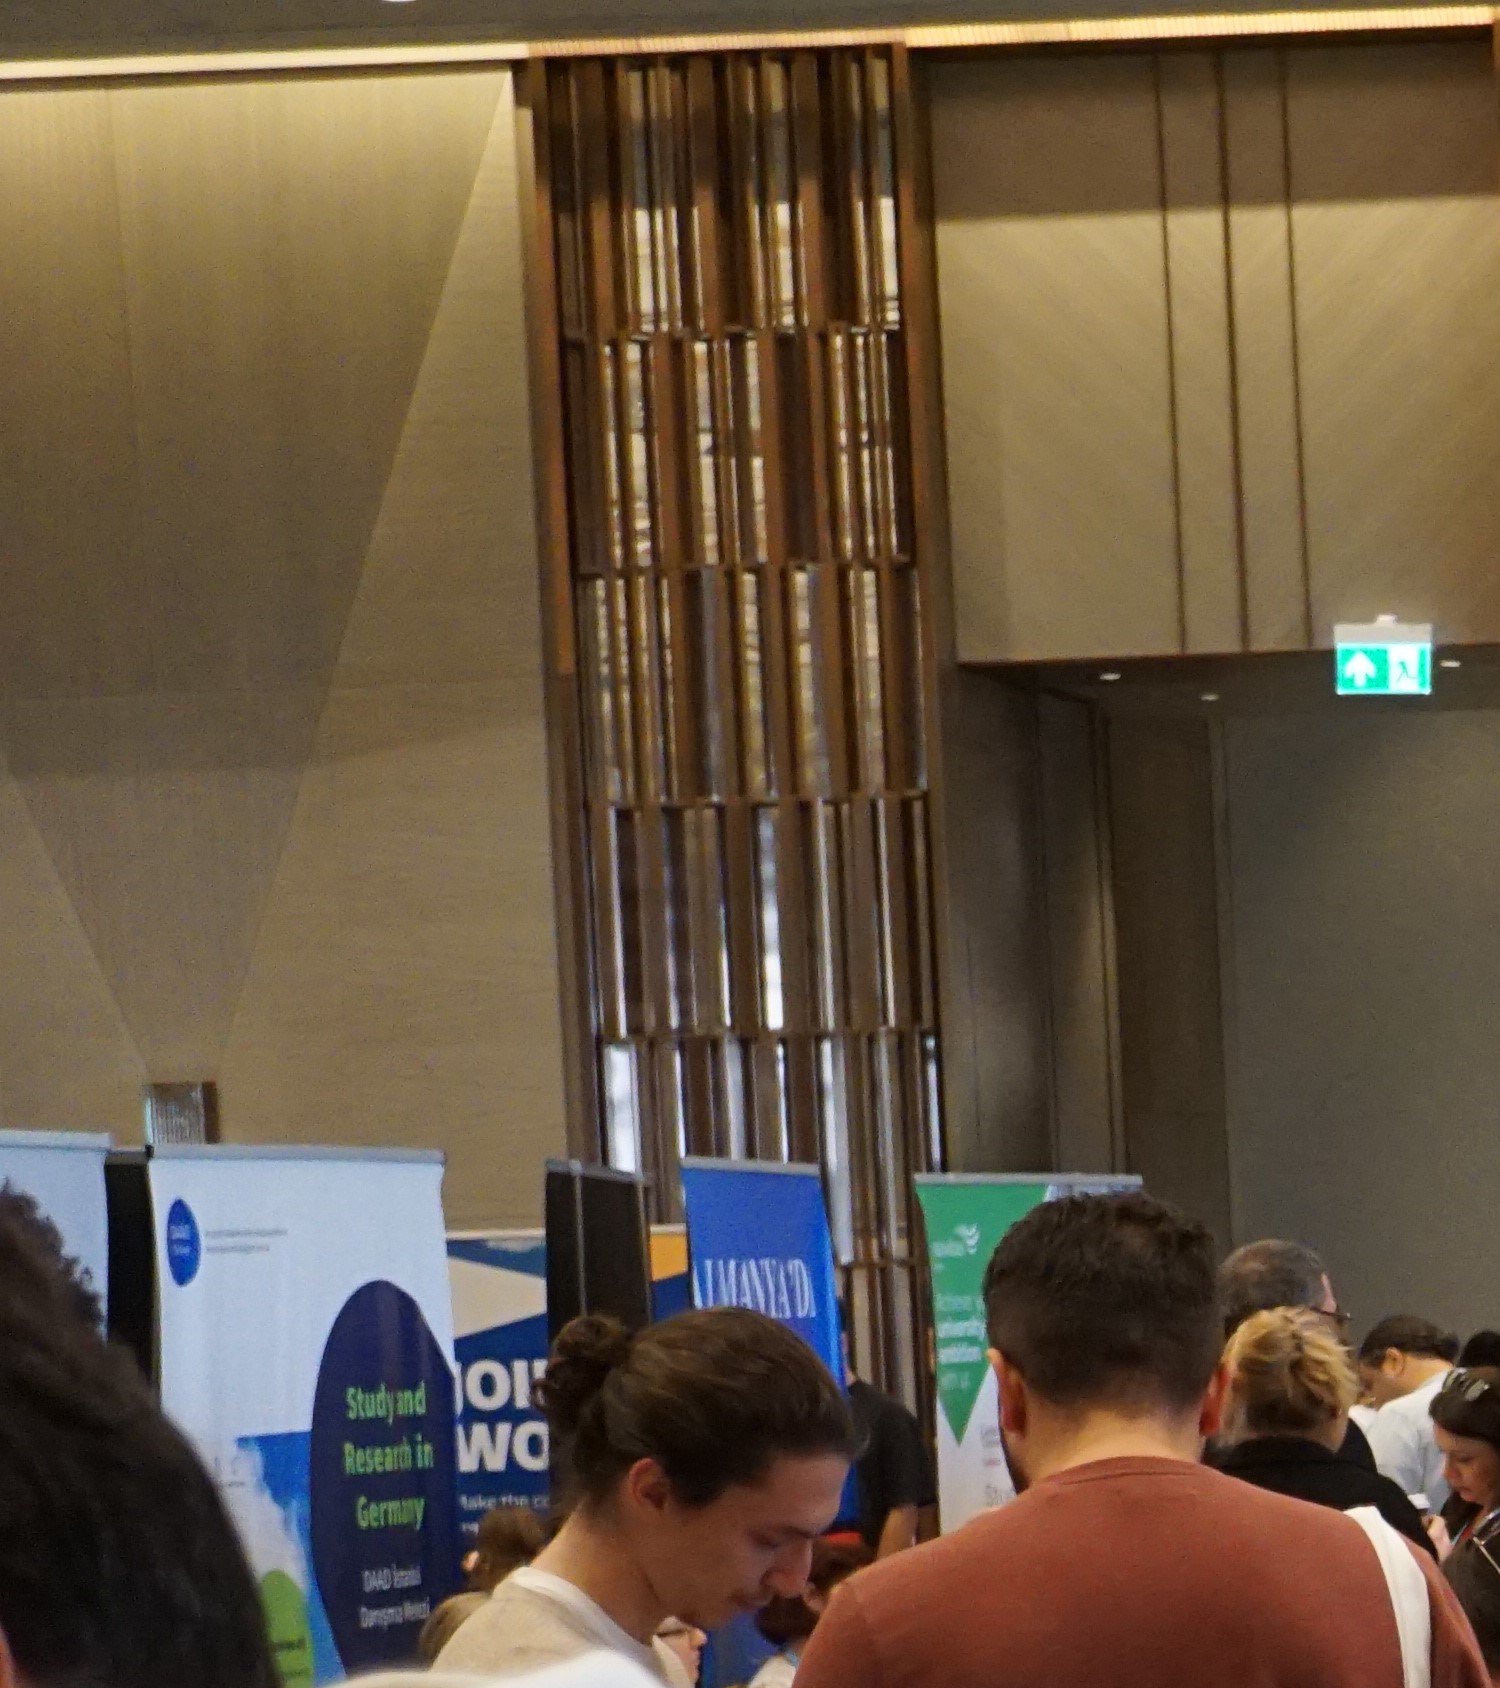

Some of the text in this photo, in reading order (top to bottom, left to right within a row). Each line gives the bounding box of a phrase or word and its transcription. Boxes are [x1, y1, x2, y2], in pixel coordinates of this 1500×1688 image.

[346, 1380, 427, 1426] Study and
[344, 1432, 434, 1475] Research in
[355, 1496, 425, 1530] Germany
